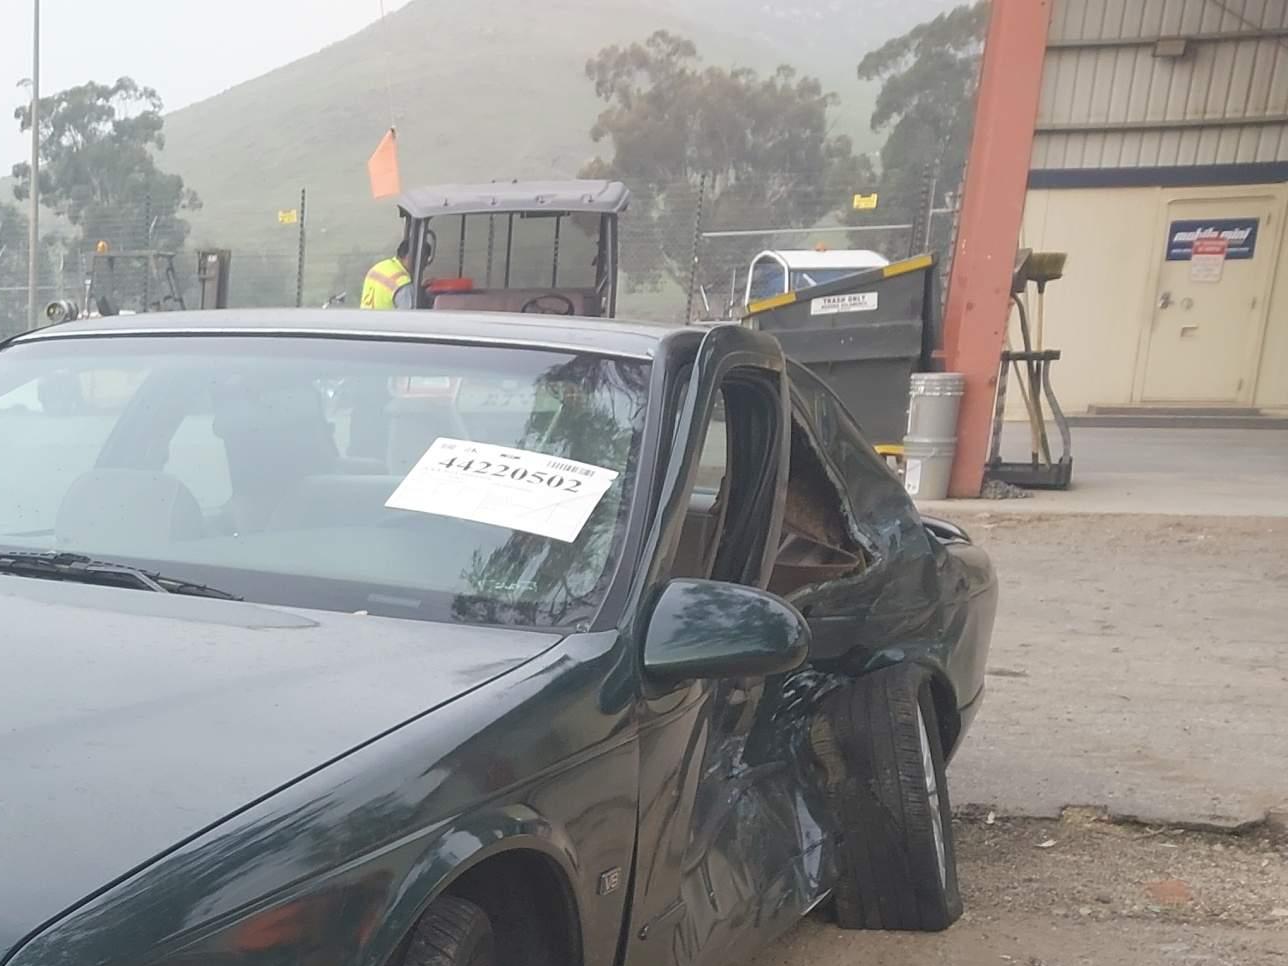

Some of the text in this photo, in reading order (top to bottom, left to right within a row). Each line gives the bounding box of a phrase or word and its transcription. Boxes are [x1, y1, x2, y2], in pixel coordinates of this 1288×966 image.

[1219, 227, 1252, 240] mini
[823, 296, 846, 305] TRASH
[847, 294, 866, 303] ONLY
[438, 456, 582, 493] 44220502
